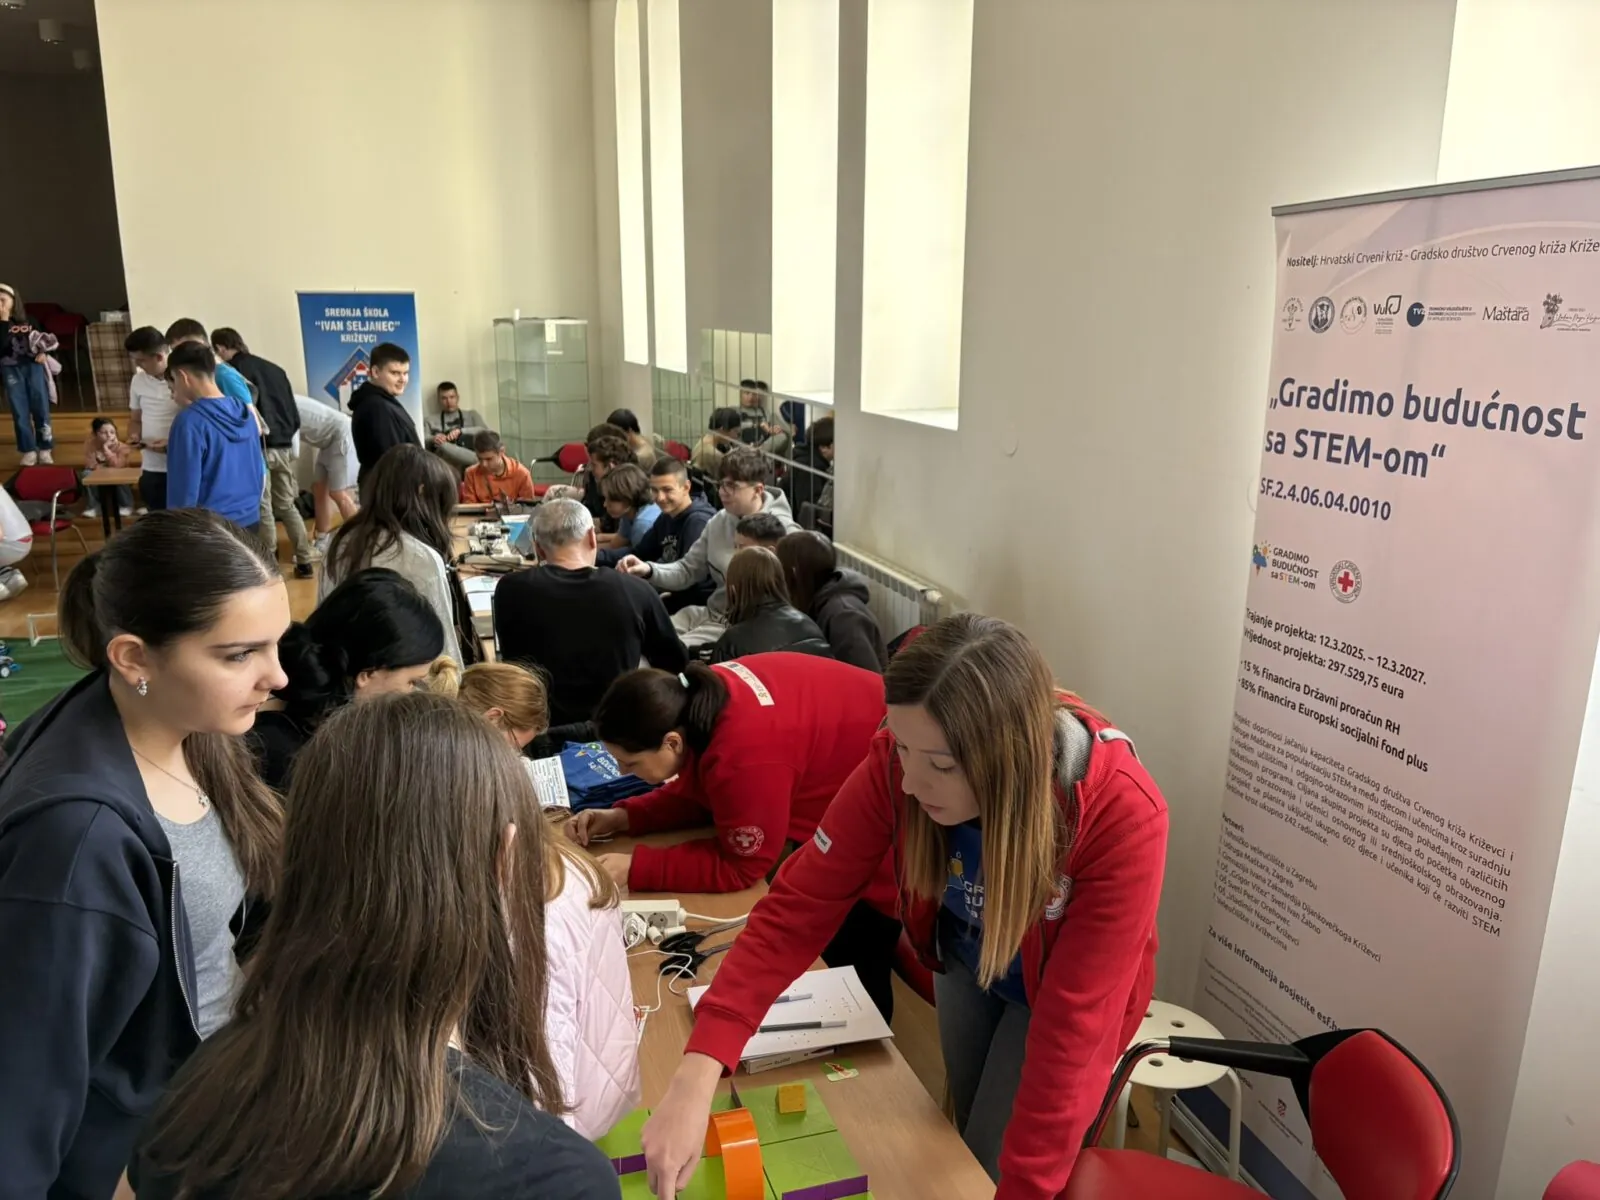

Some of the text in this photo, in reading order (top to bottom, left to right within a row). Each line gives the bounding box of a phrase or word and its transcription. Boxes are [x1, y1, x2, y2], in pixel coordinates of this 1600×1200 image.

[1286, 255, 1318, 268] Nositelj:
[1320, 253, 1355, 265] Hrvatski
[1356, 250, 1384, 264] Crveni
[1385, 249, 1403, 262] križ
[1411, 247, 1449, 261] Gradsko
[1451, 245, 1489, 259] društvo
[1491, 243, 1536, 258] Crvenog
[1539, 240, 1566, 254] križa
[324, 306, 389, 318] SREDNJA ŠKOLA
[1482, 305, 1530, 321] Maštara
[340, 332, 377, 343] KRIŽEVCI
[1269, 377, 1586, 440] „Gradimo budućnost
[1265, 429, 1286, 455] sa
[1260, 477, 1392, 521] SF.2.4.06.04.0010
[1271, 558, 1319, 579] BUDUĆNOST
[1271, 570, 1279, 580] sa
[1273, 547, 1310, 564] GRADIMO
[1274, 621, 1317, 643] projekta:
[1319, 634, 1366, 661] 12.3.2025.
[1376, 655, 1427, 685] 12.3.2027.
[1283, 645, 1326, 668] projekta:
[1328, 658, 1379, 688] 297.529,75
[1381, 681, 1404, 699] eura
[1262, 667, 1301, 692] financira
[1303, 684, 1339, 708] Državni
[1340, 700, 1383, 728] proračun
[1385, 719, 1401, 736] RH
[1257, 685, 1296, 711] financira
[1298, 703, 1339, 730] Europski
[1340, 723, 1379, 750] socijalni
[1381, 739, 1405, 760] fond
[1406, 753, 1429, 773] plus
[1252, 722, 1283, 741] doprinosi
[1284, 736, 1308, 754] jačanju
[1310, 748, 1345, 772] kapaciteta
[1347, 766, 1380, 792] Gradskog
[1383, 785, 1411, 806] društva
[1413, 801, 1444, 828] Crvenog
[1447, 820, 1466, 838] križa
[1469, 832, 1506, 858] Križevci
[1277, 747, 1284, 756] za
[1285, 751, 1331, 779] popularizaciju
[1332, 772, 1357, 792] STEM-a
[1358, 788, 1379, 804] među
[1380, 799, 1407, 820] djecom
[1412, 818, 1449, 844] učenicima
[1450, 837, 1468, 856] kroz
[1469, 850, 1511, 877] suradnju
[1259, 802, 1284, 820] ukupno
[1285, 814, 1297, 828] 242
[1296, 768, 1364, 810] odgojno-obrazovnim
[1367, 804, 1414, 838] institucijama
[1417, 835, 1463, 869] pohađanjem
[1467, 865, 1508, 892] različitih
[1256, 775, 1296, 801] obrazovanja
[1305, 800, 1329, 818] učenici
[1332, 816, 1366, 842] osnovnog
[1370, 835, 1378, 847] ili
[1381, 843, 1441, 888] srednjoškolskog
[1446, 884, 1502, 922] obrazovanja.
[1262, 791, 1285, 808] planira
[1315, 820, 1340, 839] ukupno
[1342, 834, 1356, 848] 602
[1358, 844, 1378, 862] djece
[1386, 861, 1414, 884] učenika
[1417, 878, 1430, 895] koji
[1433, 890, 1441, 903] će
[1444, 899, 1469, 920] razviti
[1472, 915, 1500, 937] STEM
[1297, 781, 1319, 800] Ciljana
[1321, 795, 1347, 815] skupina
[1348, 811, 1379, 833] projekta
[1381, 829, 1390, 839] su
[1392, 835, 1412, 853] djeca
[1414, 848, 1424, 860] do
[1427, 857, 1457, 882] početka
[1460, 878, 1505, 909] obveznog
[1272, 868, 1294, 889] Zagreb
[1292, 867, 1318, 890] Zagrebu
[1301, 912, 1321, 934] Žabno
[1302, 902, 1352, 943] Dijankovečkoga
[1353, 938, 1381, 963] Križevci
[1208, 924, 1217, 938] Za
[1217, 934, 1233, 951] više
[1234, 943, 1278, 984] informacija
[1279, 980, 1316, 1014] posjetite
